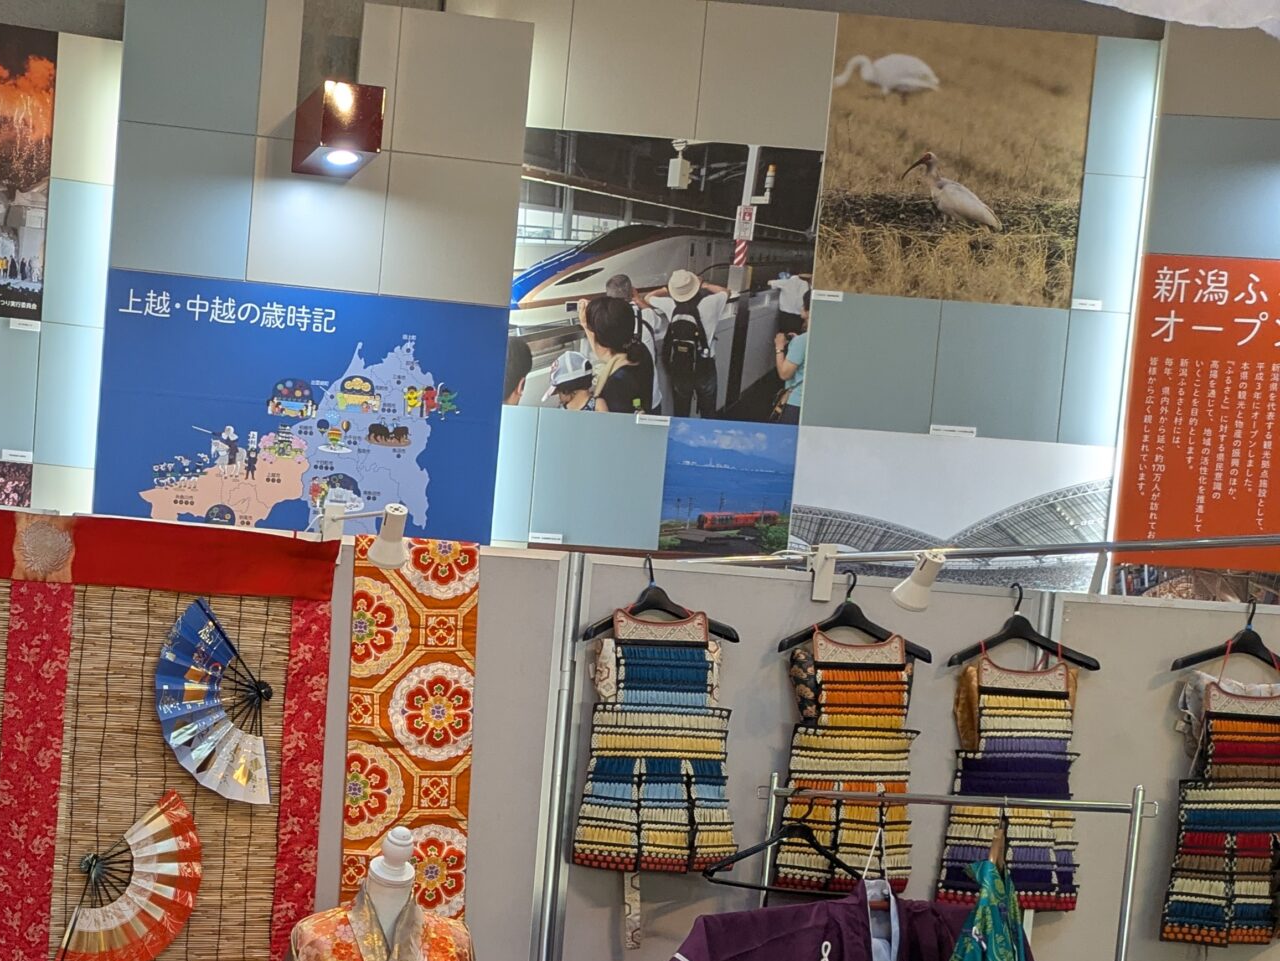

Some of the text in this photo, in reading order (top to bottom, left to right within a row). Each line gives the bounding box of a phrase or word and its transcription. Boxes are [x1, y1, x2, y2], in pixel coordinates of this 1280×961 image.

[118, 288, 337, 334] 上越・中越の歳時記
[1137, 356, 1158, 496] 皆様から広く親しまれています。
[1147, 357, 1173, 554] 毎年、県内外から延べ約170万人が訪れてお、
[1172, 358, 1189, 448] 新潟ふるさと村には、
[1185, 360, 1204, 470] いくことを目的とします。
[1244, 362, 1266, 492] 平成3年にオープンしました。
